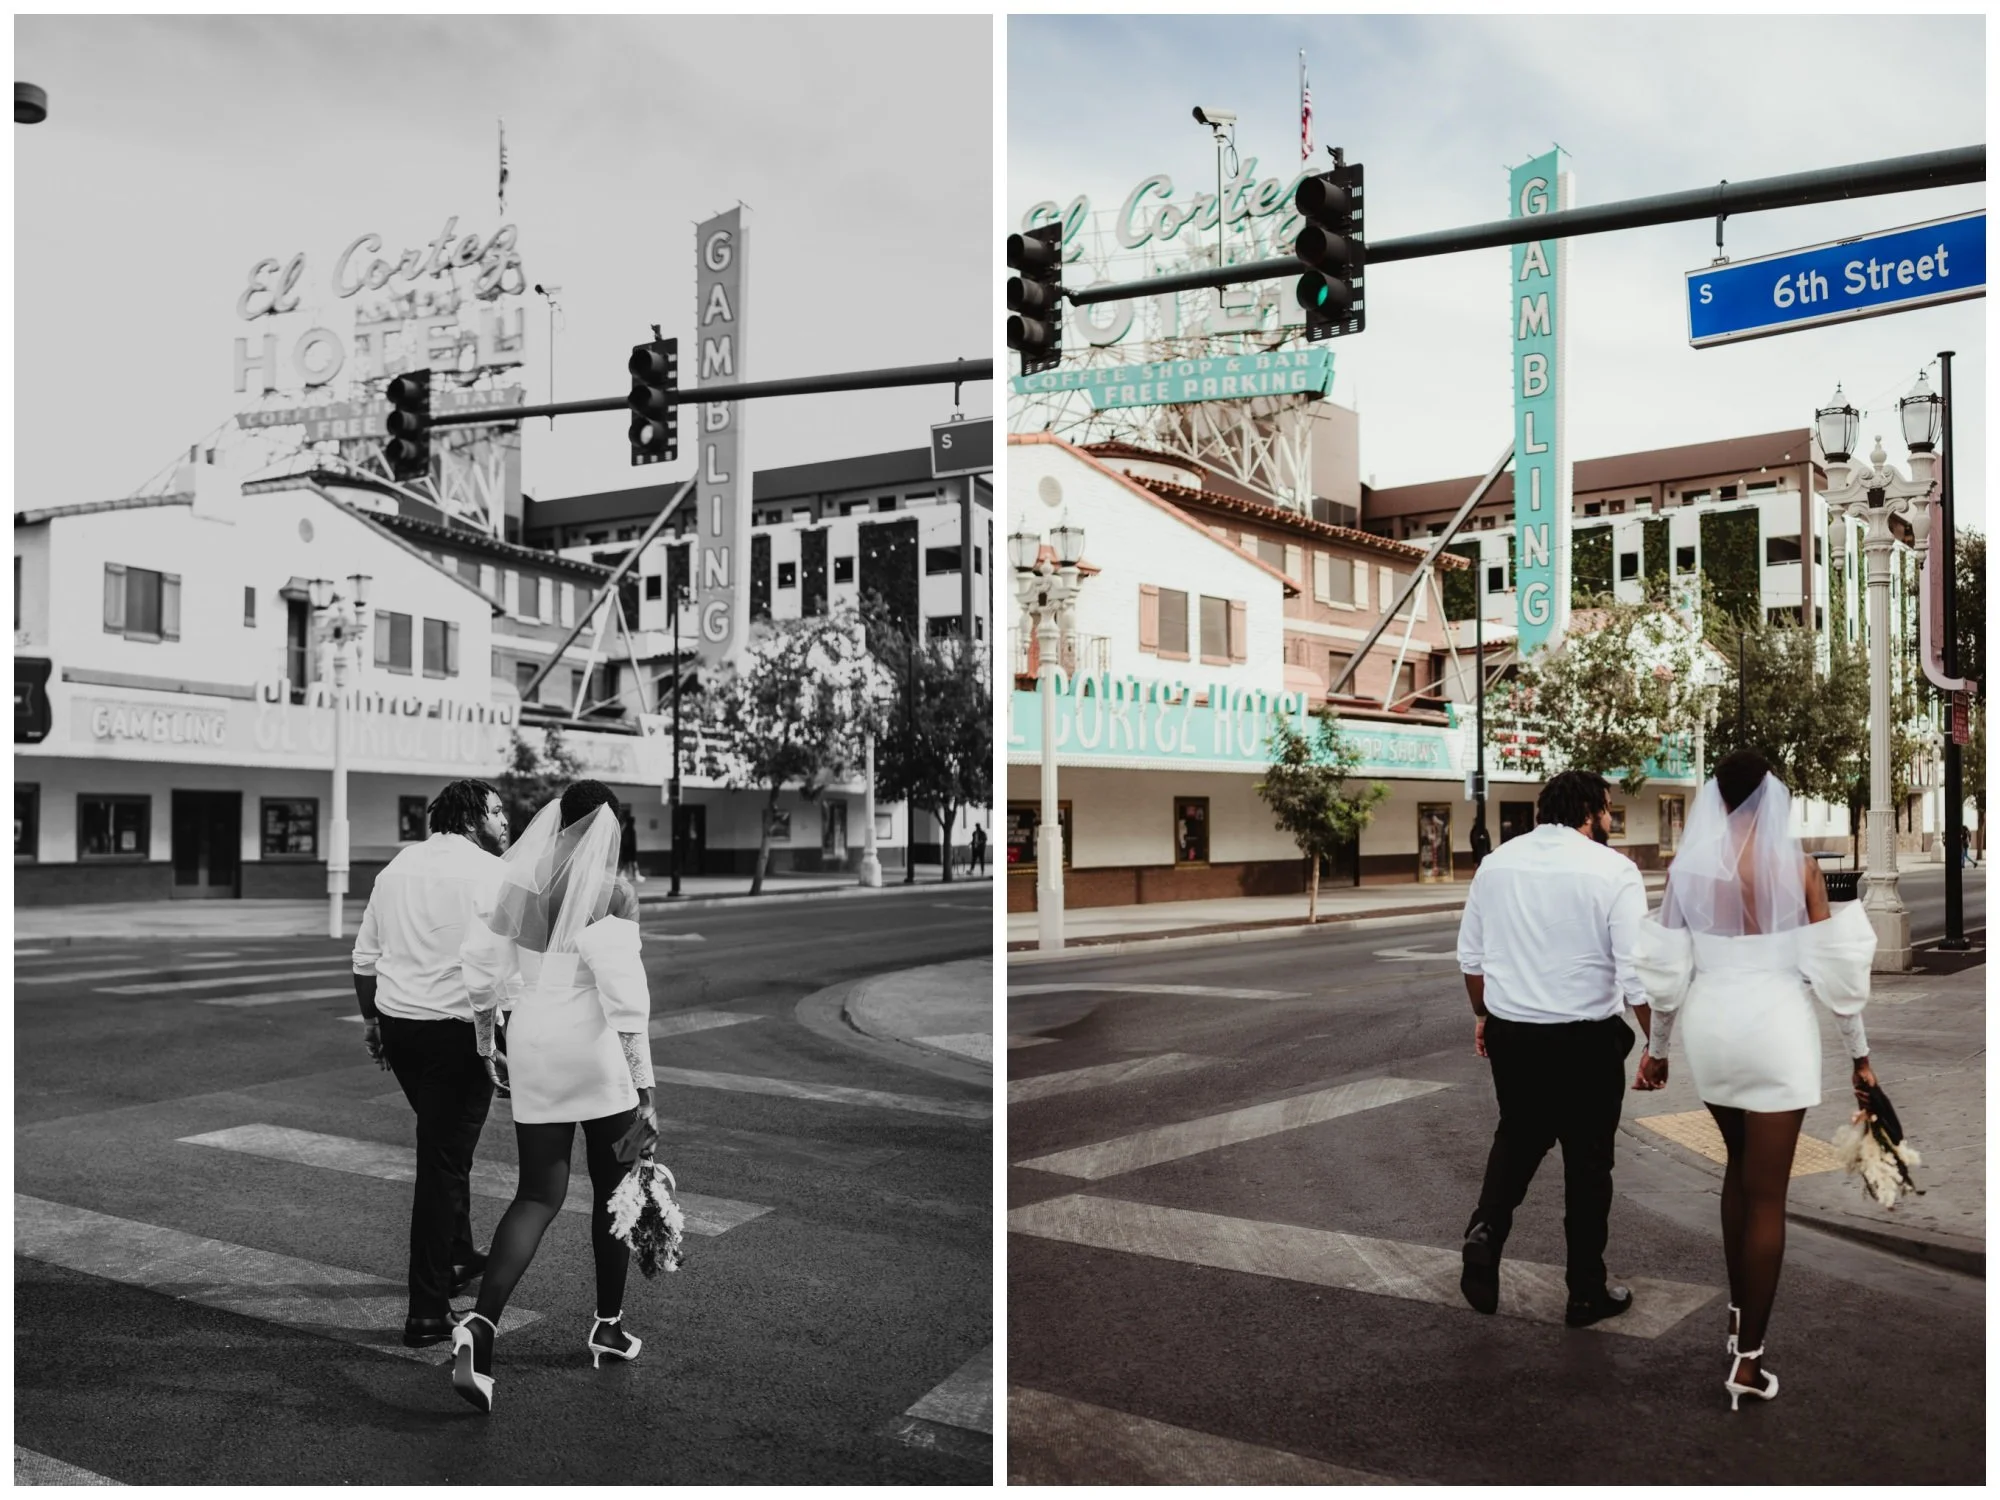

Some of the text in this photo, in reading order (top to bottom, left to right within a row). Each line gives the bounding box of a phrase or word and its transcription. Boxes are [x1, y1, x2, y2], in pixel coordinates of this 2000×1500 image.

[236, 216, 520, 321] El Cortez
[1700, 244, 1950, 309] S 6th Street
[234, 307, 524, 393] HOTEL
[1024, 352, 1310, 390] COFFEE SHOP & BAR
[1104, 370, 1307, 405] FREE PARKING
[1518, 177, 1551, 626] GAMBLING
[316, 416, 377, 439] FREE
[701, 229, 734, 645] GAMBLING
[941, 433, 953, 449] S
[91, 704, 226, 746] GAMBLING
[1387, 738, 1439, 763] SHOWS
